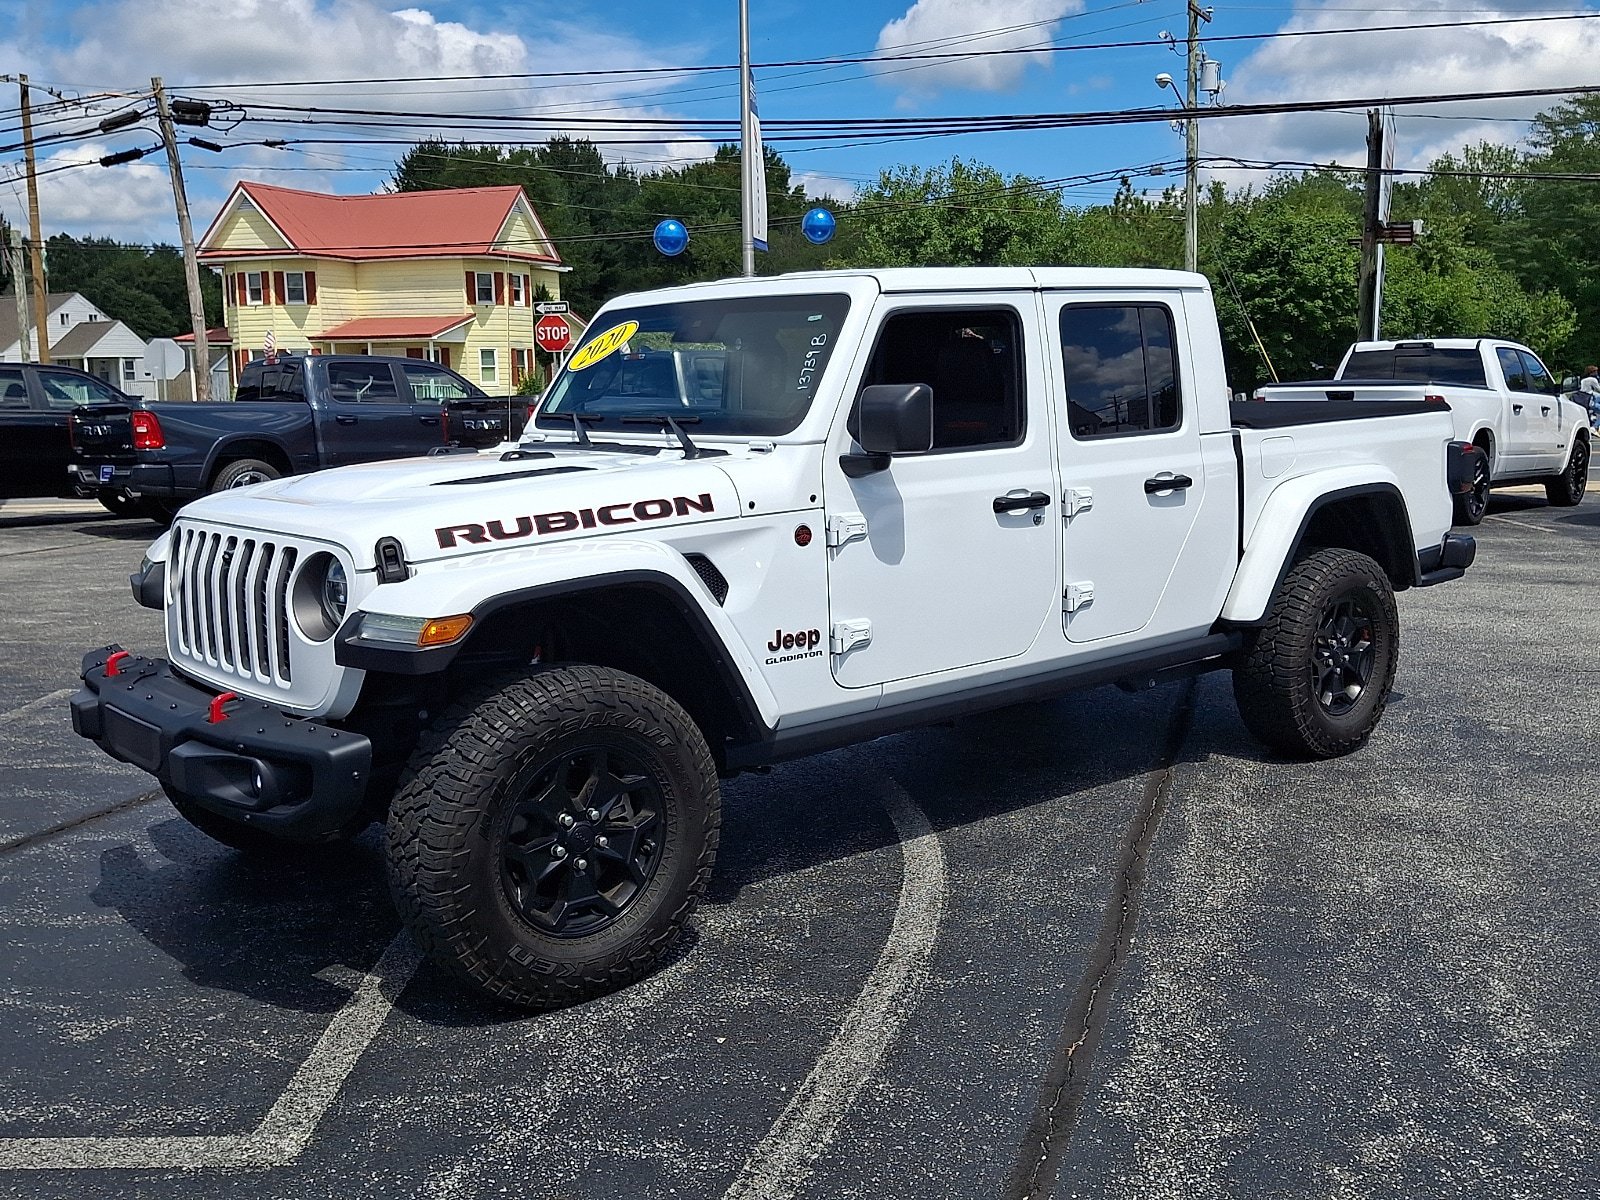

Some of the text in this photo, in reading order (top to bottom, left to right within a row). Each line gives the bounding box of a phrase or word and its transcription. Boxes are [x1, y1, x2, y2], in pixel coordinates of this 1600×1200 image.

[538, 327, 568, 340] STOP
[576, 325, 628, 367] 2020
[797, 333, 827, 390] 13739 B
[83, 425, 112, 436] RAM
[463, 419, 501, 430] RAM
[434, 493, 715, 549] RUBICON
[767, 629, 821, 652] Jeep
[765, 650, 823, 665] GLADIATOR
